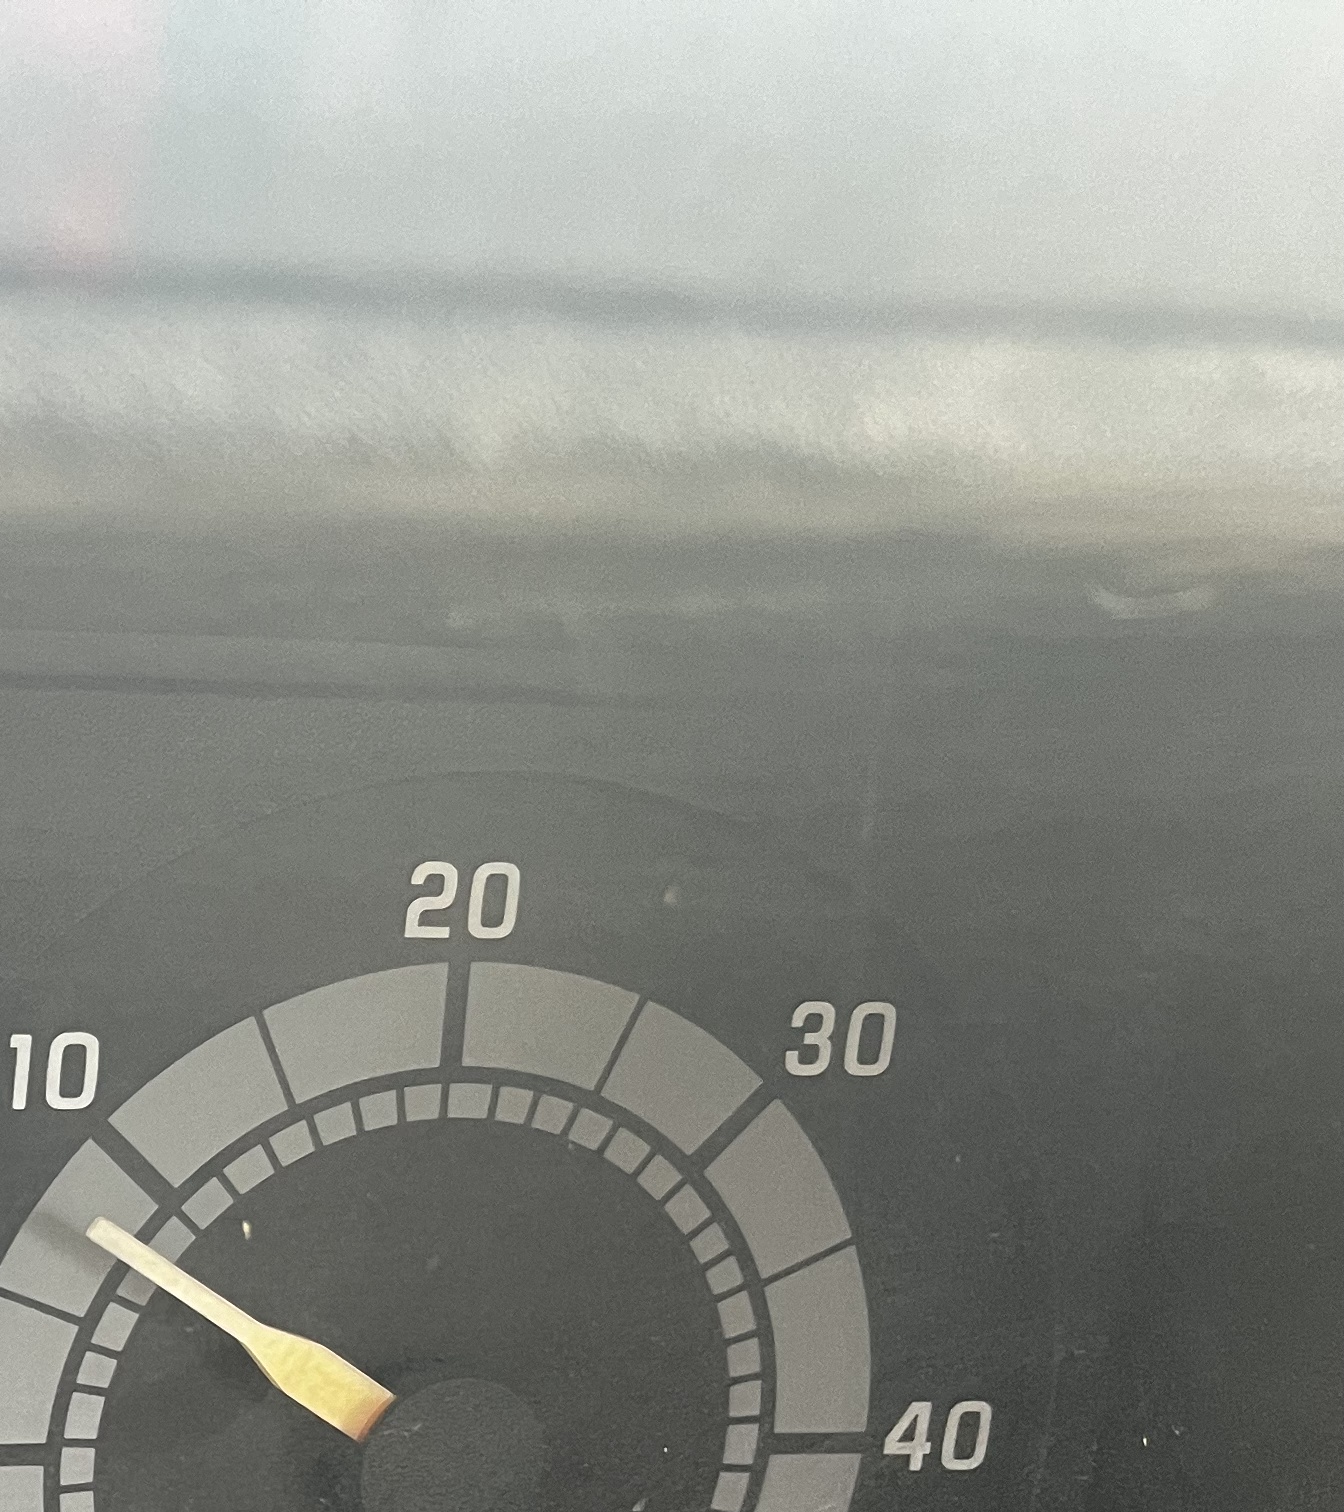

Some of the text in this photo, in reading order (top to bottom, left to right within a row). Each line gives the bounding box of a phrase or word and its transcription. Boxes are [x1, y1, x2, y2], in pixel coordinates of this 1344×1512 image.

[404, 861, 521, 939] 20
[9, 1031, 101, 1110] 10
[784, 1001, 897, 1077] 30
[882, 1400, 994, 1472] 40
